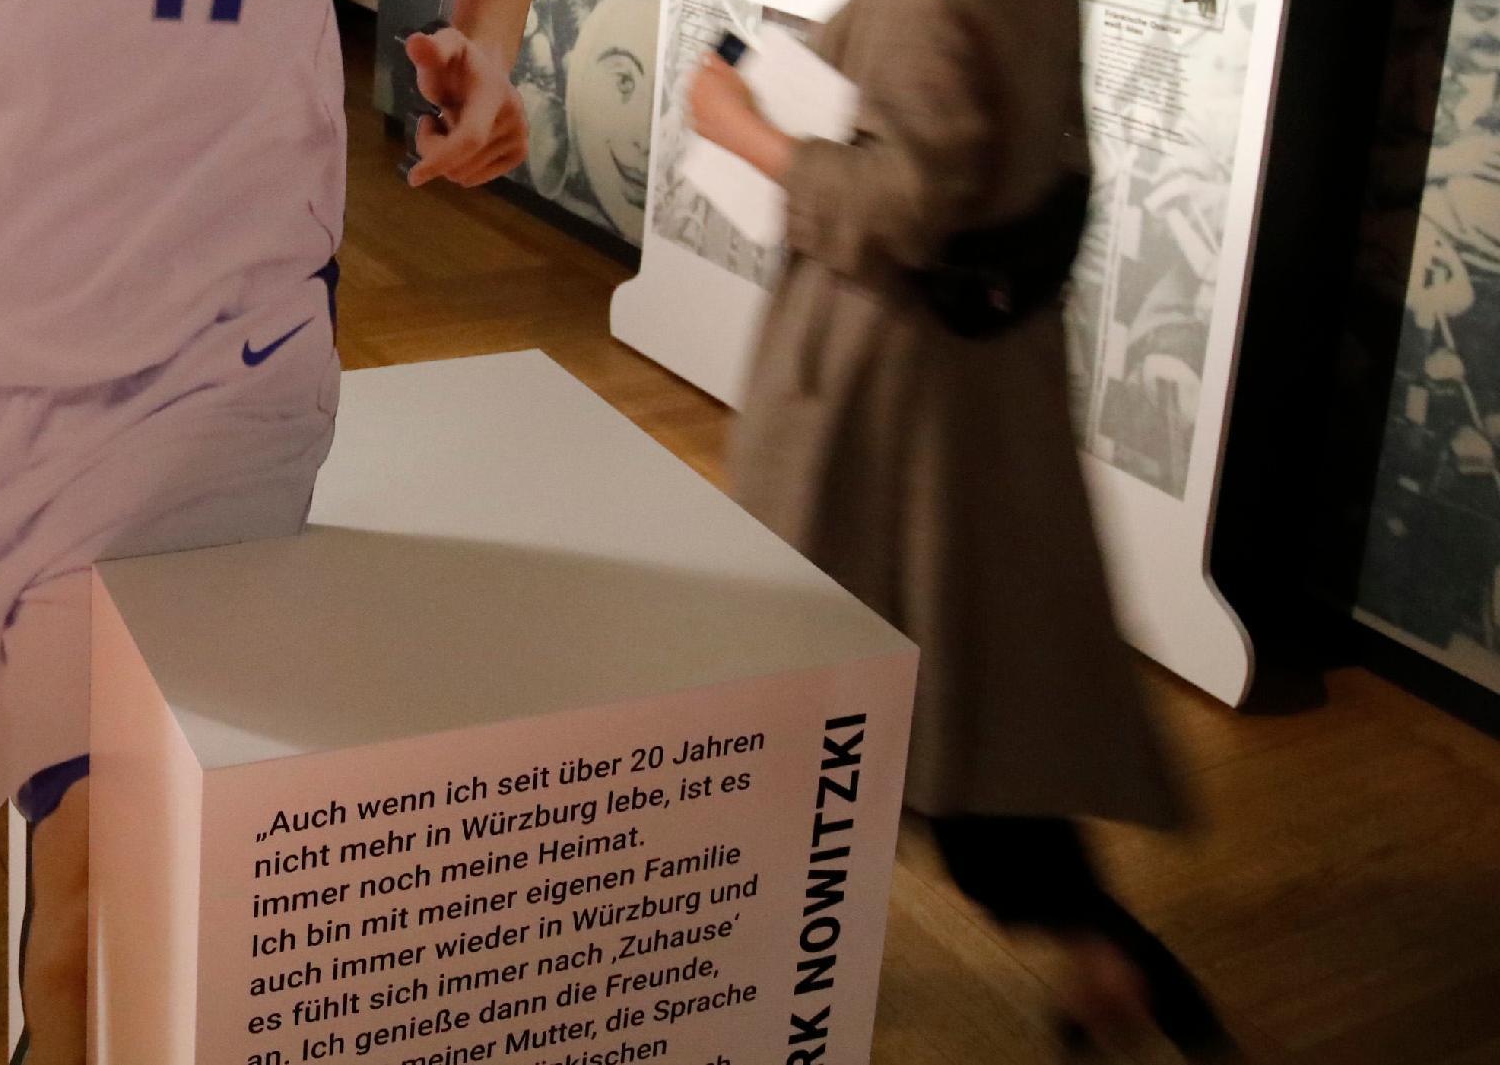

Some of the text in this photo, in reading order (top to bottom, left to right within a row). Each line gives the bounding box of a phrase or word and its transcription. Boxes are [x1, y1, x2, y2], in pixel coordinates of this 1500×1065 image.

[357, 790, 435, 820] wenn
[446, 776, 487, 805] ich
[497, 766, 550, 796] seit
[559, 758, 623, 785] über
[630, 745, 664, 772] 20
[672, 732, 765, 765] Jahren
[255, 772, 751, 879] nicht mehr in Würzburg lebe, ist es
[794, 713, 867, 996] NOWITZKI
[252, 844, 741, 957] Ich bin mit meiner eigenen Familie
[253, 827, 645, 918] immer noch meine Heimat.
[250, 873, 759, 996] auch immer wieder in Würzburg und
[248, 1012, 282, 1034] es
[292, 992, 360, 1026] fühlt
[369, 978, 428, 1010] sich
[438, 961, 529, 997] immer
[537, 943, 603, 976] nach
[302, 1032, 344, 1061] Ich
[355, 1009, 471, 1056] genieße
[479, 994, 547, 1024] dann
[556, 982, 597, 1007] die
[605, 956, 719, 998] Freunde,
[505, 1020, 598, 1055] Mutter,
[605, 1007, 645, 1033] die
[653, 984, 757, 1024] Sprache
[535, 1039, 667, 1065] kischen
[786, 1004, 831, 1065] RK
